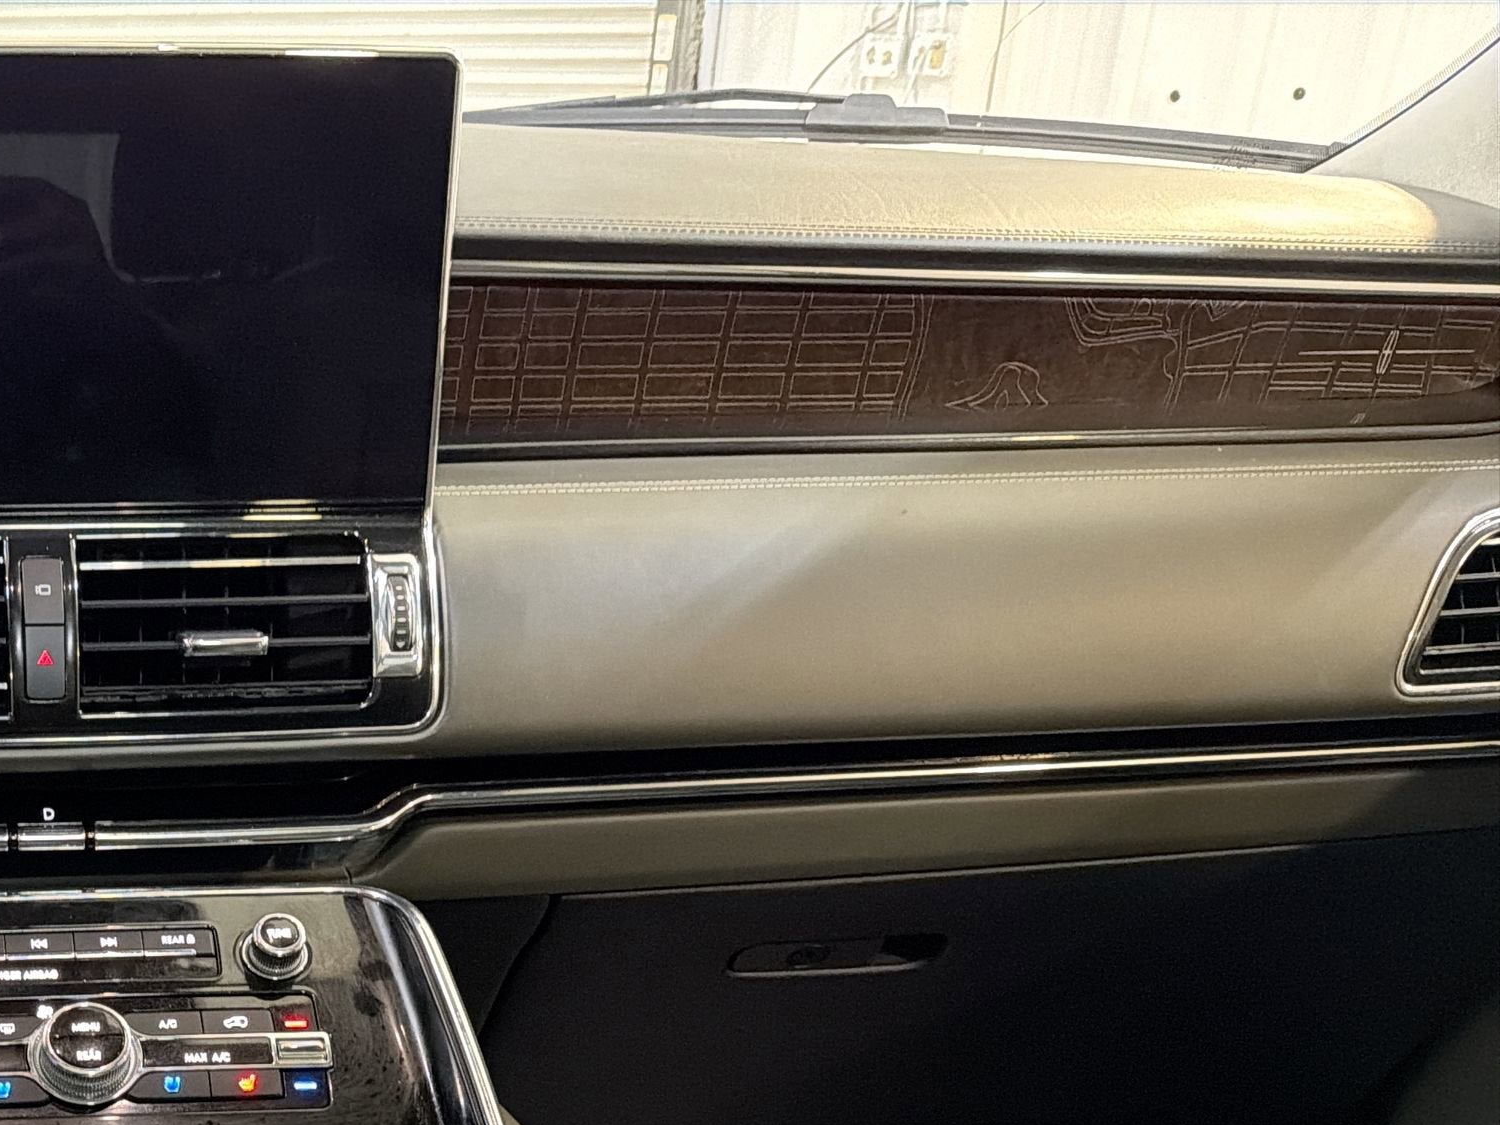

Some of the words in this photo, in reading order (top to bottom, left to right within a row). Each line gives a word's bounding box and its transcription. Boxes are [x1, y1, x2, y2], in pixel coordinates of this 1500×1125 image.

[43, 808, 55, 821] D
[161, 935, 185, 945] REAR
[23, 968, 59, 981] AIRBAG
[71, 1021, 100, 1033] MENU
[159, 1018, 177, 1029] A/C
[76, 1050, 101, 1062] REAR
[184, 1052, 207, 1063] MAX
[212, 1051, 231, 1063] A/C
